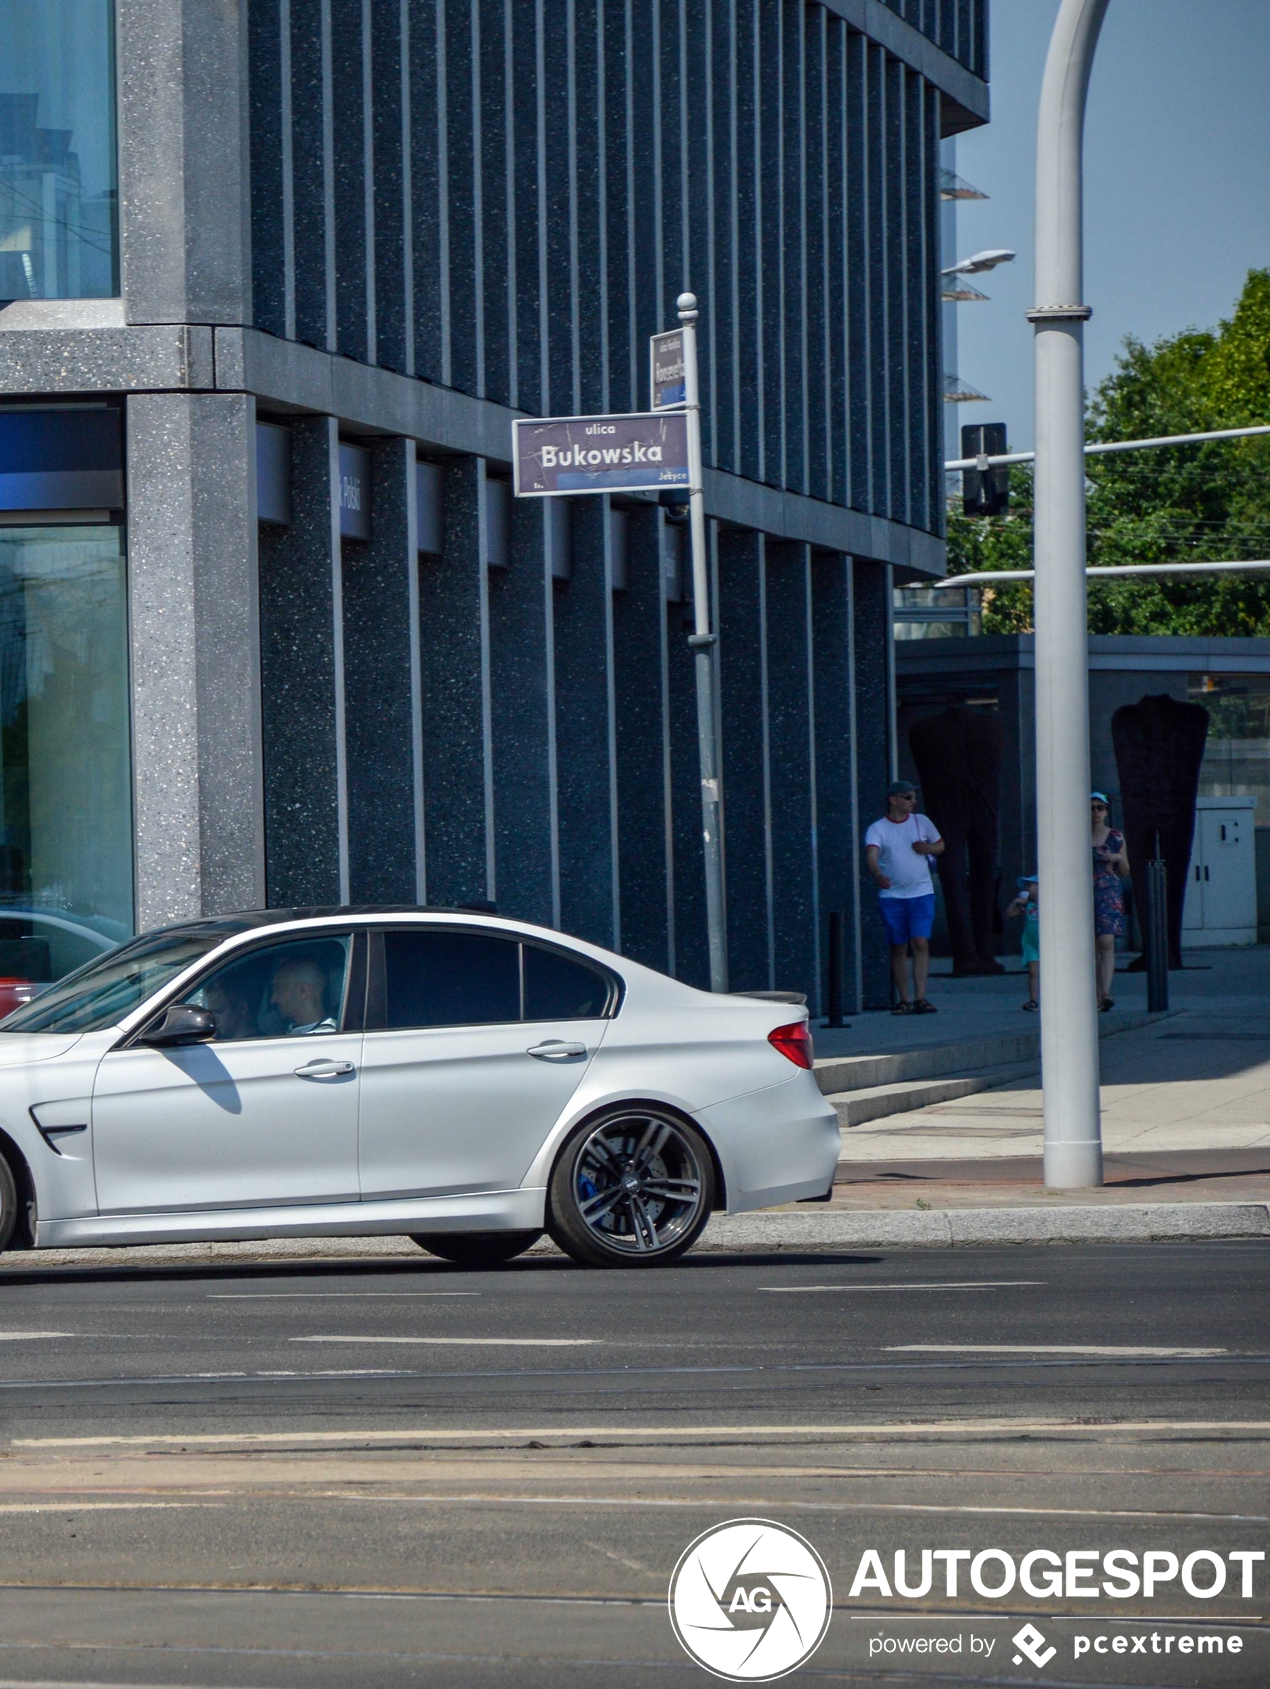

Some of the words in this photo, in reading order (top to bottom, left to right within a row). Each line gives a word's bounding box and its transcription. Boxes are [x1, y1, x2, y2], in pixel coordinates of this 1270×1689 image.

[585, 424, 615, 435] ulica
[541, 441, 662, 467] Bukowska
[658, 471, 687, 482] Jeżyce
